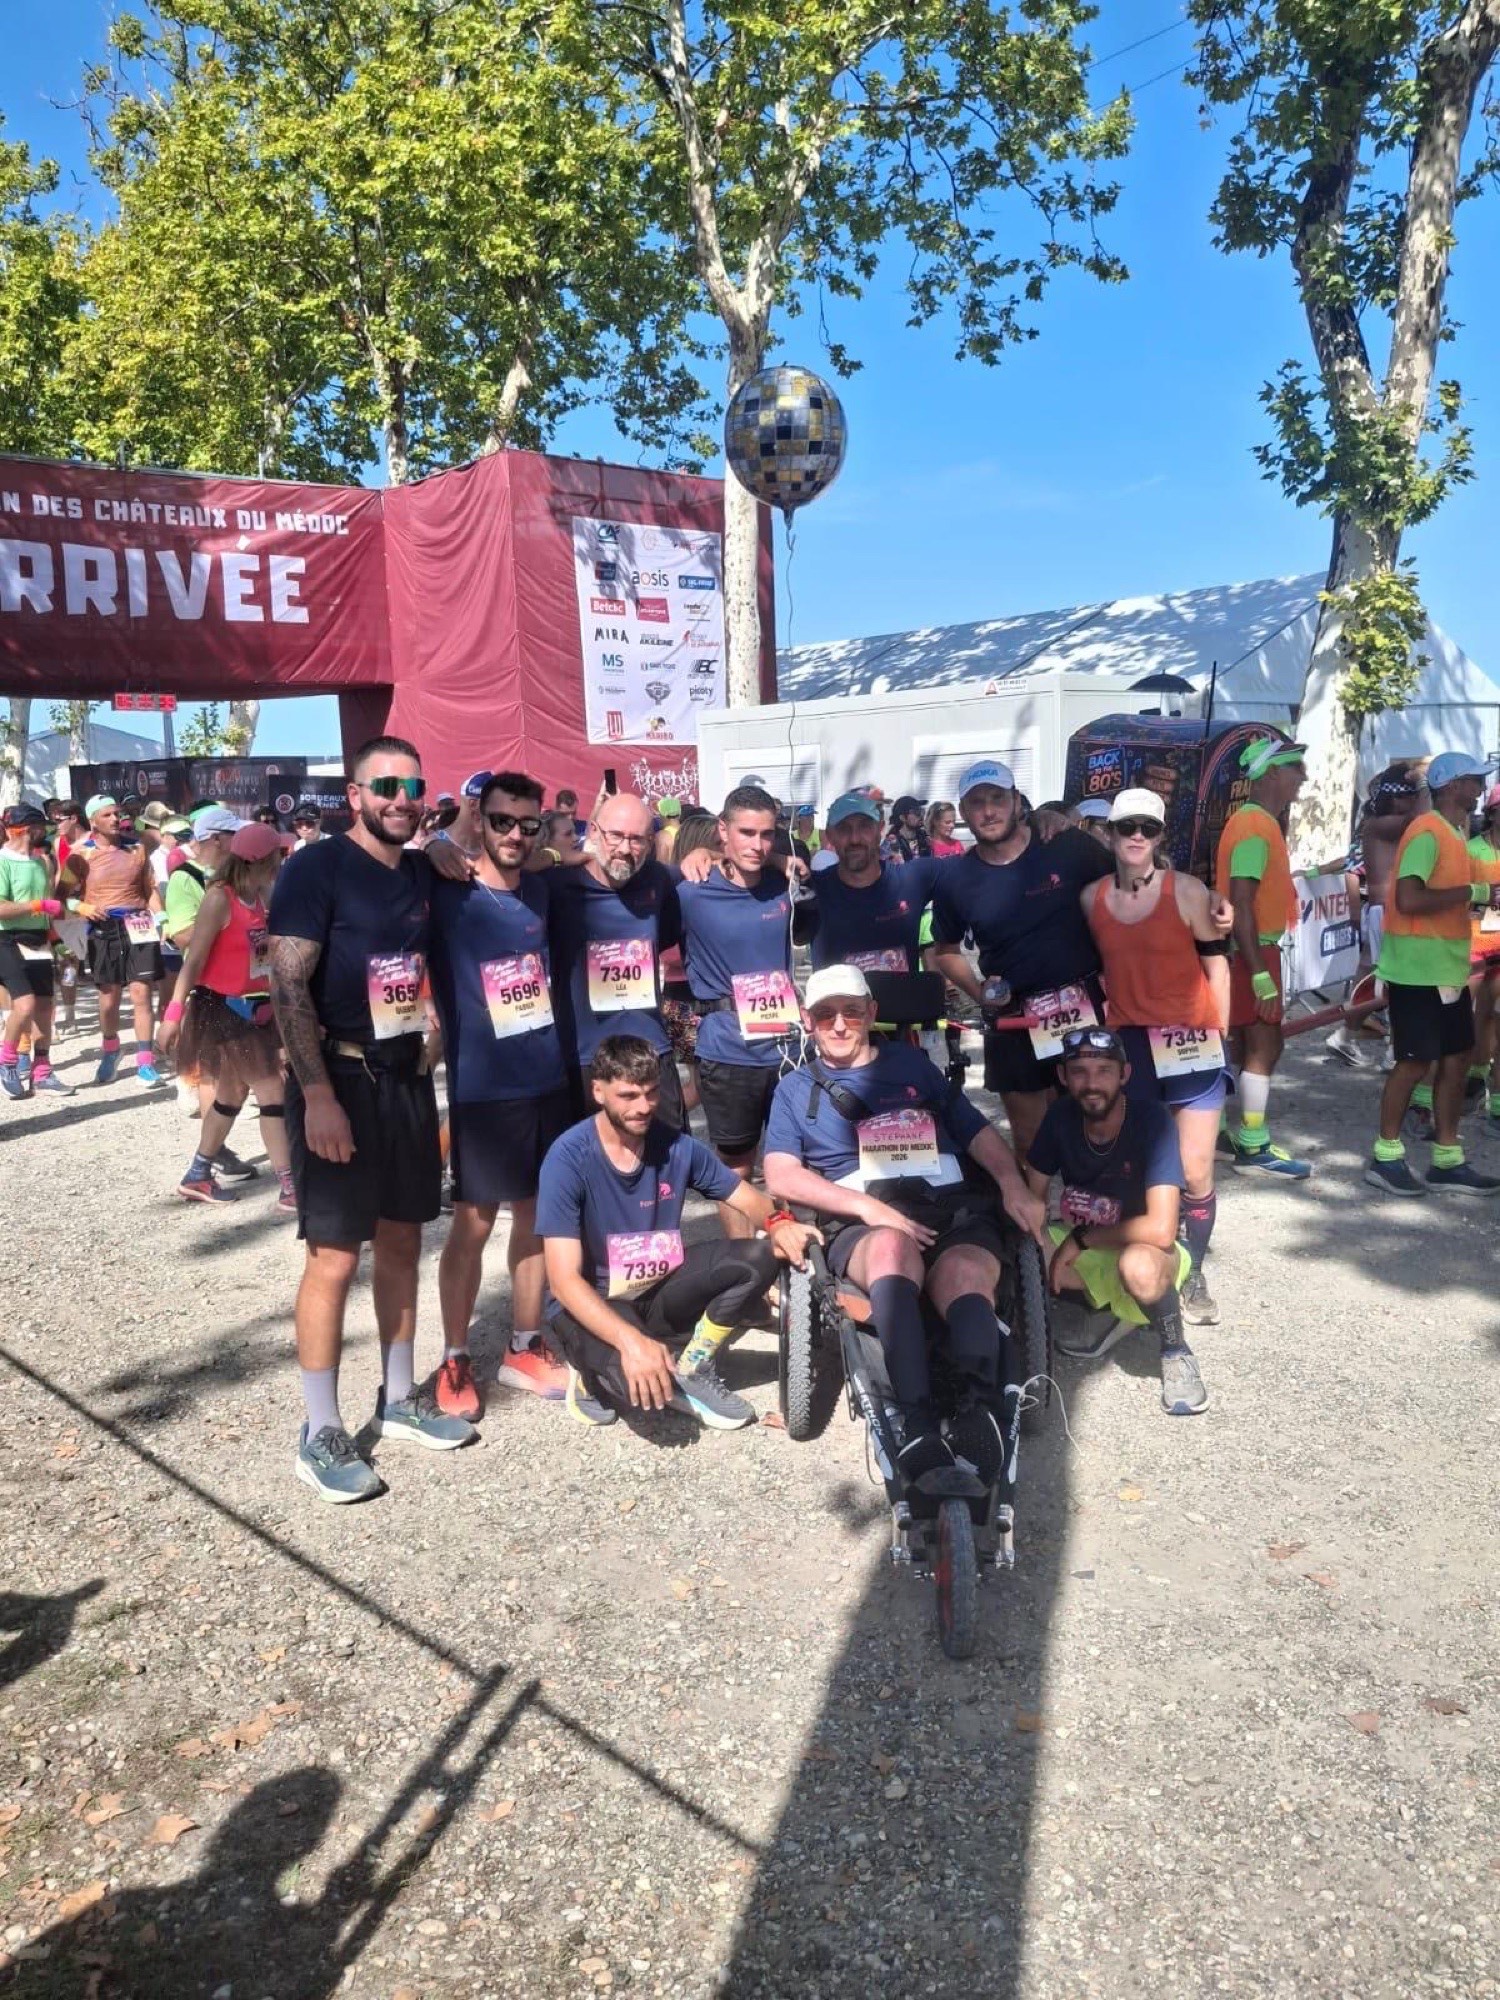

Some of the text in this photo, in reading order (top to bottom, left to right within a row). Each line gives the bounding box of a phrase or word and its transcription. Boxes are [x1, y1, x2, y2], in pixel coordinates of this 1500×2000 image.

[32, 494, 83, 519] DES
[95, 497, 227, 529] CHÂTEAUX
[237, 510, 266, 531] DU
[276, 508, 349, 535] MÉDOC
[632, 569, 669, 587] aosis
[595, 628, 629, 644] MIRA
[602, 654, 624, 667] MS
[1089, 750, 1120, 769] BACK
[600, 965, 641, 982] 7340
[383, 983, 419, 1004] 365
[500, 980, 541, 1005] 5696
[748, 994, 785, 1013] 7341
[1040, 1008, 1083, 1031] 7342
[1162, 1029, 1207, 1048] 7343
[623, 1261, 669, 1280] 7339
